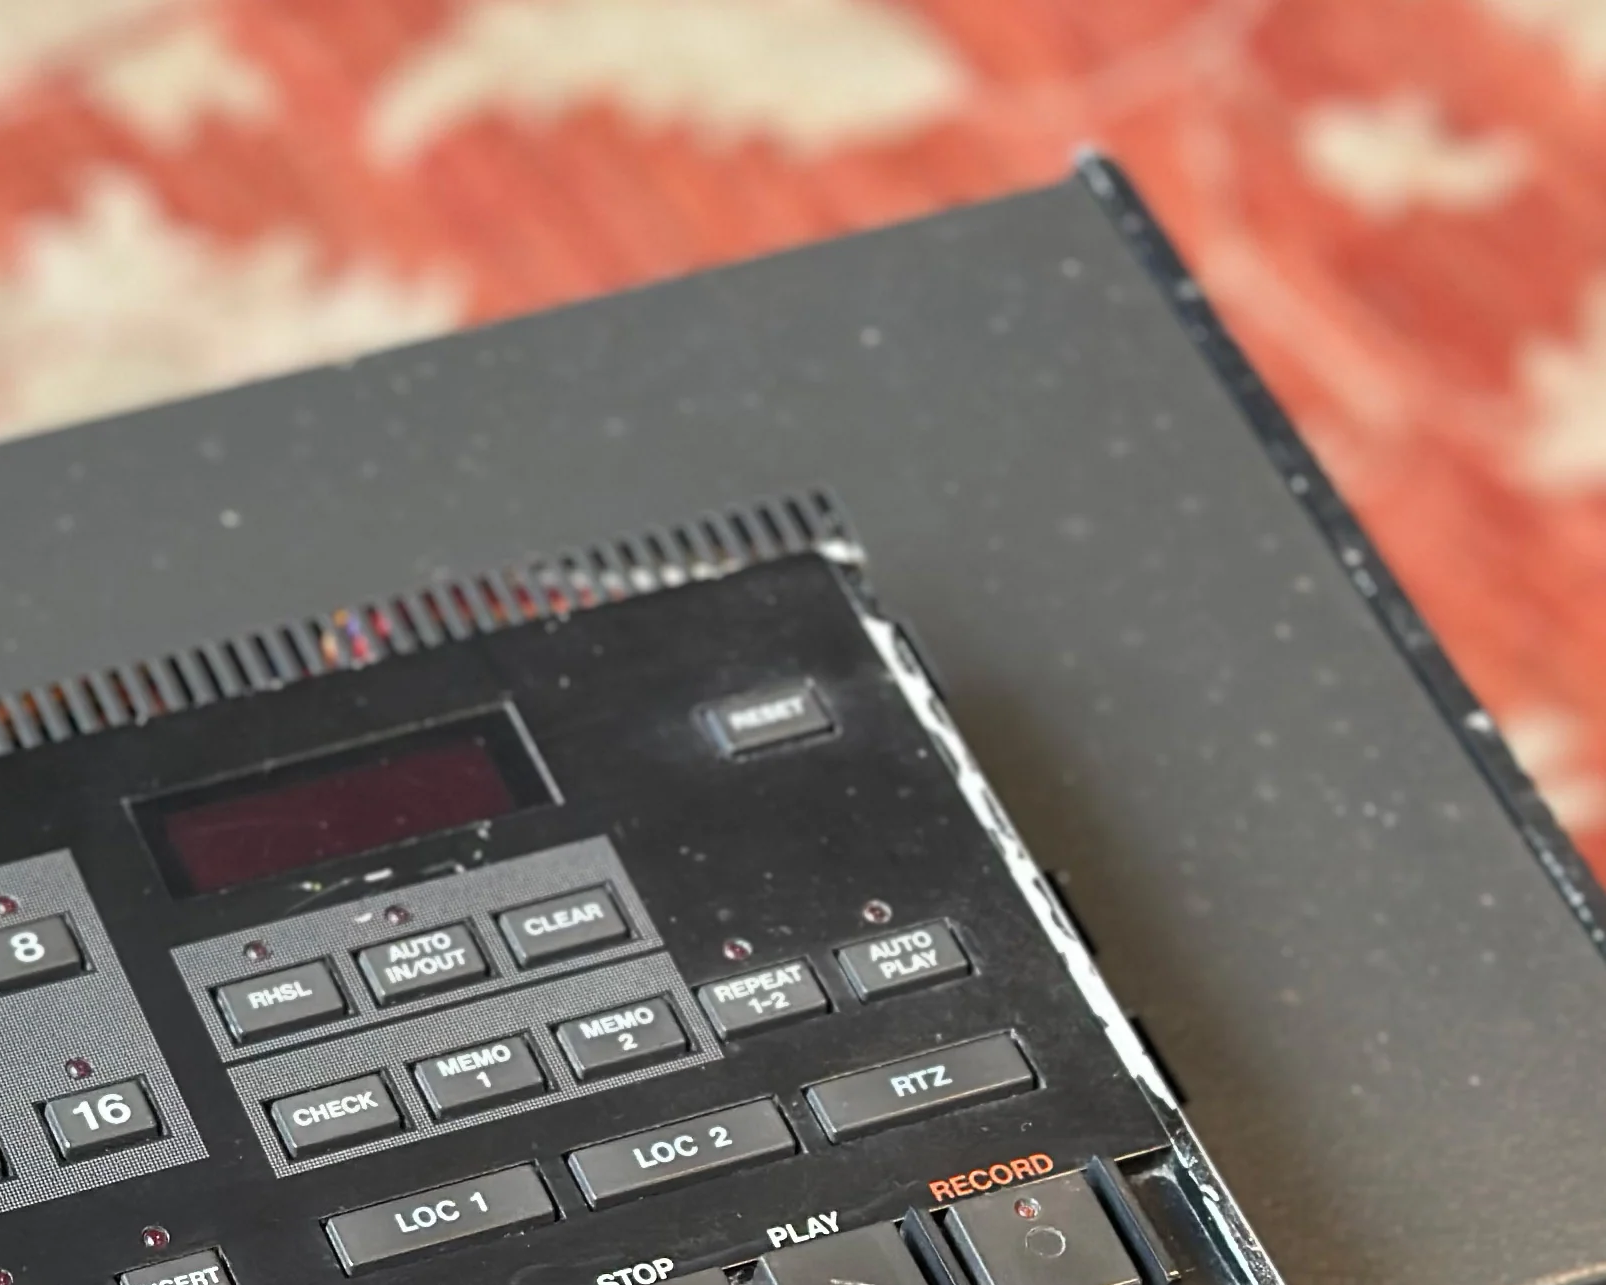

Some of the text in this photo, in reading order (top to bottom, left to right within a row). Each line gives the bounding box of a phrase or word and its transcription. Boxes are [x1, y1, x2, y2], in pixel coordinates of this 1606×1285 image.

[524, 903, 603, 935] CLEAR
[11, 932, 44, 962] 8
[389, 932, 451, 962] AUTO
[870, 931, 932, 961] AUTO
[385, 948, 465, 983] IN/OUT
[879, 950, 937, 978] PLAY
[248, 982, 312, 1008] RHSL
[713, 965, 801, 1002] REPEAT
[748, 992, 789, 1013] 1-2
[579, 1007, 654, 1038] MEMO
[618, 1034, 637, 1050] 2
[437, 1045, 511, 1076] MEMO
[477, 1072, 491, 1087] 1
[891, 1066, 952, 1096] RTZ
[73, 1094, 131, 1130] 16
[293, 1092, 378, 1126] CHECK
[633, 1127, 732, 1168] LOC 2
[929, 1154, 1054, 1201] RECORD
[395, 1192, 487, 1232] LOC 1
[767, 1211, 838, 1248] PLAY
